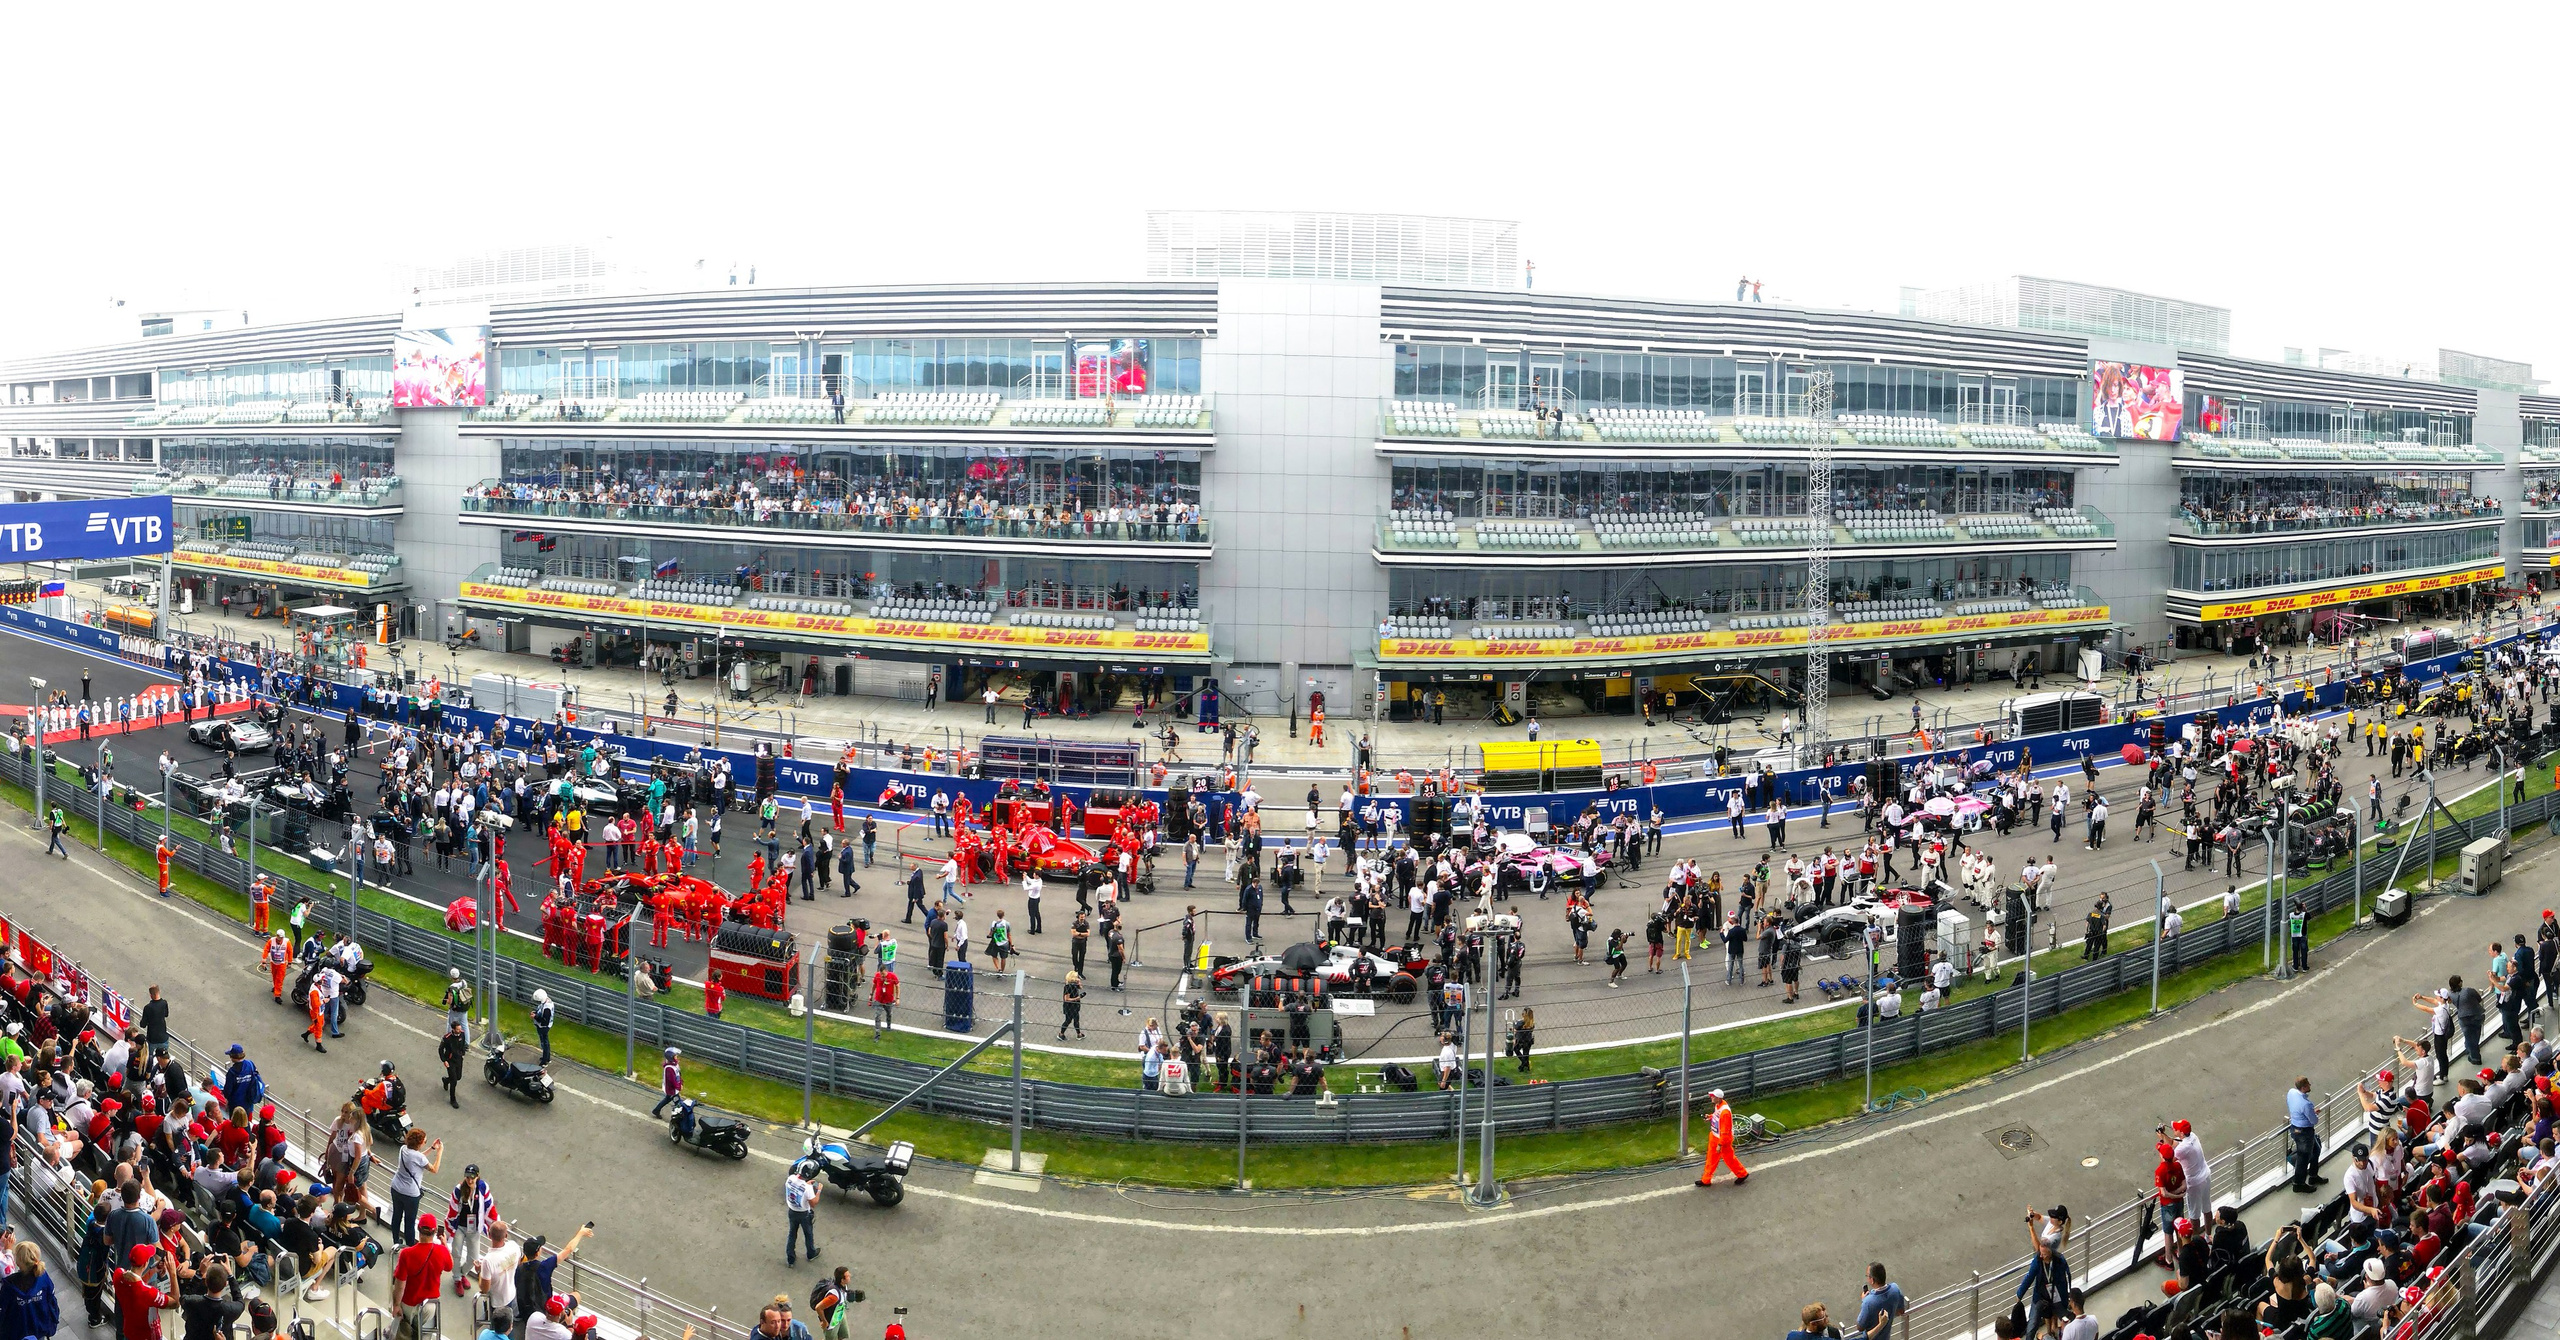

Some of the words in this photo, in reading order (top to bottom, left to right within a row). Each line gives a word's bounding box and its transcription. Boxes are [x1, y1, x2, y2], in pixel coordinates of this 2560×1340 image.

[110, 516, 163, 545] VTB
[0, 523, 43, 552] TB
[203, 555, 227, 566] DHL
[238, 560, 264, 571] DHL
[276, 564, 303, 576] DHL
[316, 569, 346, 581] DHL
[2476, 569, 2495, 580] DHL
[2420, 579, 2441, 590] DHL
[2450, 574, 2469, 585] DHL
[470, 586, 507, 599] DHL
[2349, 587, 2374, 599] DHL
[2385, 583, 2408, 595] DHL
[526, 592, 566, 605] DHL
[587, 598, 630, 612] DHL
[2266, 599, 2296, 611] DHL
[2310, 592, 2337, 605] DHL
[650, 604, 697, 618] DHL
[2067, 609, 2103, 621] DHL
[2223, 604, 2253, 617] DHL
[9, 613, 18, 622] VTB
[720, 611, 771, 625] DHL
[1946, 617, 1989, 631] DHL
[2009, 612, 2049, 625] DHL
[38, 620, 47, 629] VTB
[795, 617, 849, 632] DHL
[875, 622, 930, 637] DHL
[1881, 622, 1925, 636] DHL
[69, 628, 78, 637] VTB
[958, 627, 1016, 642] DHL
[1044, 632, 1104, 645] DHL
[1734, 631, 1786, 645] DHL
[102, 636, 112, 646] VTB
[1133, 635, 1194, 648] DHL
[1572, 640, 1628, 654] DHL
[1654, 635, 1708, 650] DHL
[1396, 642, 1456, 655] DHL
[2431, 664, 2441, 673] VTB
[2258, 706, 2272, 716] VTB
[450, 716, 468, 727] VTB
[2141, 728, 2150, 739] VT
[2071, 739, 2090, 750] VTB
[1825, 754, 1834, 762] 11
[1995, 750, 2015, 763] VTB
[793, 771, 819, 785] VTB
[1196, 779, 1206, 787] 20
[1609, 777, 1618, 785] 16
[1819, 776, 1842, 789] VTB
[900, 783, 927, 798] VTB
[1609, 799, 1637, 813] VTB
[1492, 807, 1521, 820] VTB
[1557, 846, 1573, 854] BWT
[281, 1284, 287, 1292] 3
